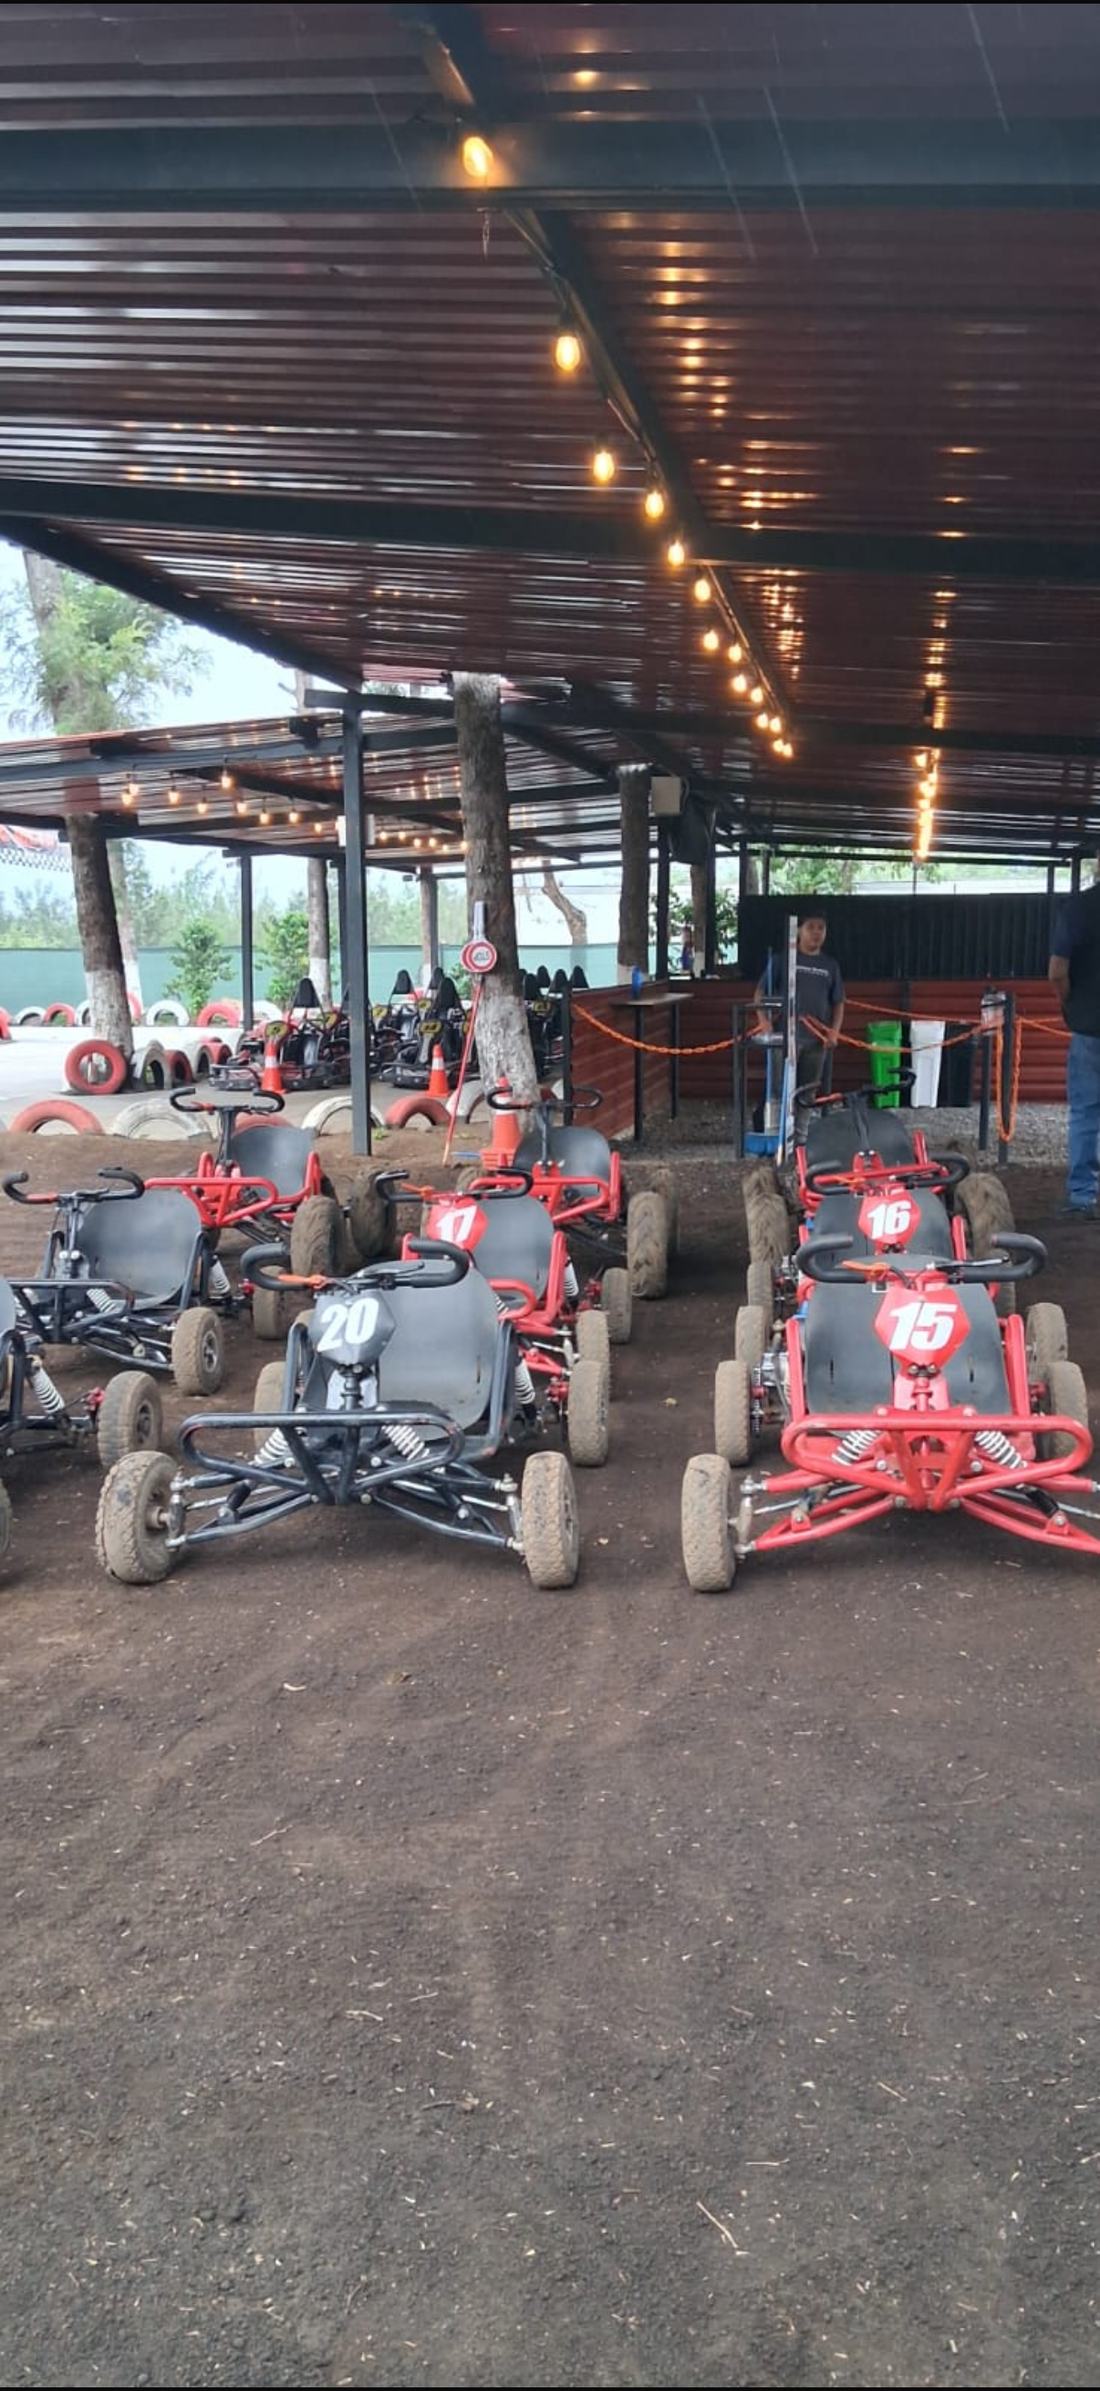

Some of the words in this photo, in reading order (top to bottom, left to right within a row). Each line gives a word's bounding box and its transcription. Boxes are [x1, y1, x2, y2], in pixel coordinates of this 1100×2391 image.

[436, 1205, 477, 1247] 17
[867, 1200, 911, 1240] 16
[317, 1297, 379, 1353] 20
[889, 1301, 958, 1351] 15
